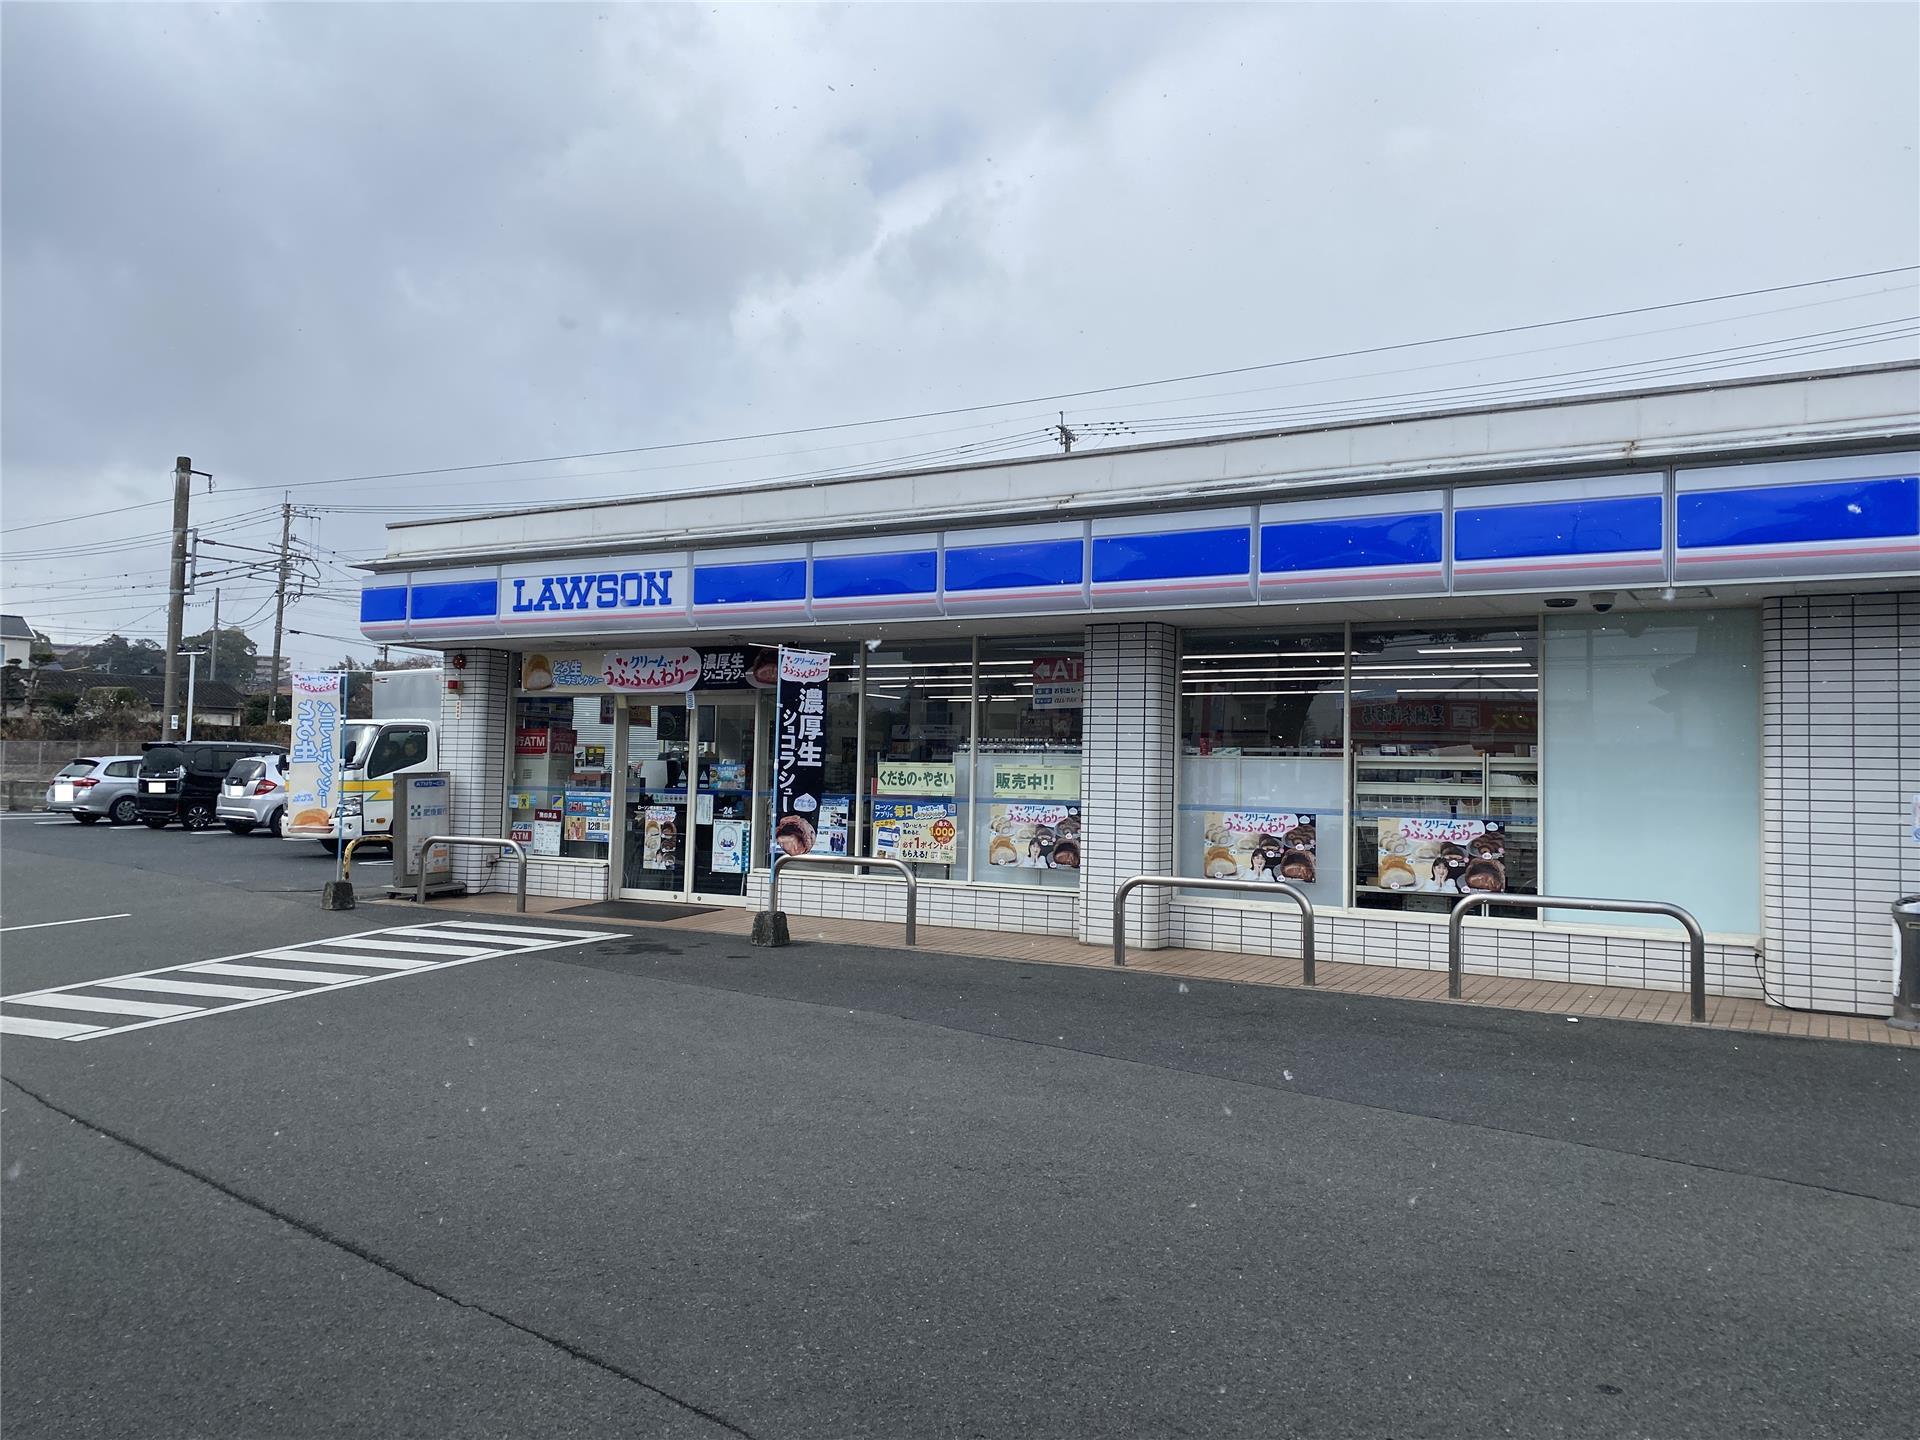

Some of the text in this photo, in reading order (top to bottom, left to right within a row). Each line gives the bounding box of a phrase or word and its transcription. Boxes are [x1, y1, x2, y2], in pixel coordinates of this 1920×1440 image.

[513, 570, 673, 612] LAWSON
[552, 659, 581, 676] とろ生
[630, 656, 673, 668] クリームで
[703, 653, 744, 670] 濃厚生
[703, 669, 753, 681] ショコラシュー
[1051, 659, 1083, 680] AT
[552, 675, 604, 686] バニラミルクシュー
[797, 688, 824, 767] 濃厚生
[778, 709, 797, 812] ショコラシュー
[879, 770, 954, 787] くだもの・やさい
[995, 773, 1054, 790] 販売中!!
[894, 804, 913, 818] 毎日
[1244, 813, 1278, 822] クリームで
[1424, 820, 1462, 829] クリームで
[511, 832, 529, 840] ATM
[902, 850, 928, 859] もらえる!
